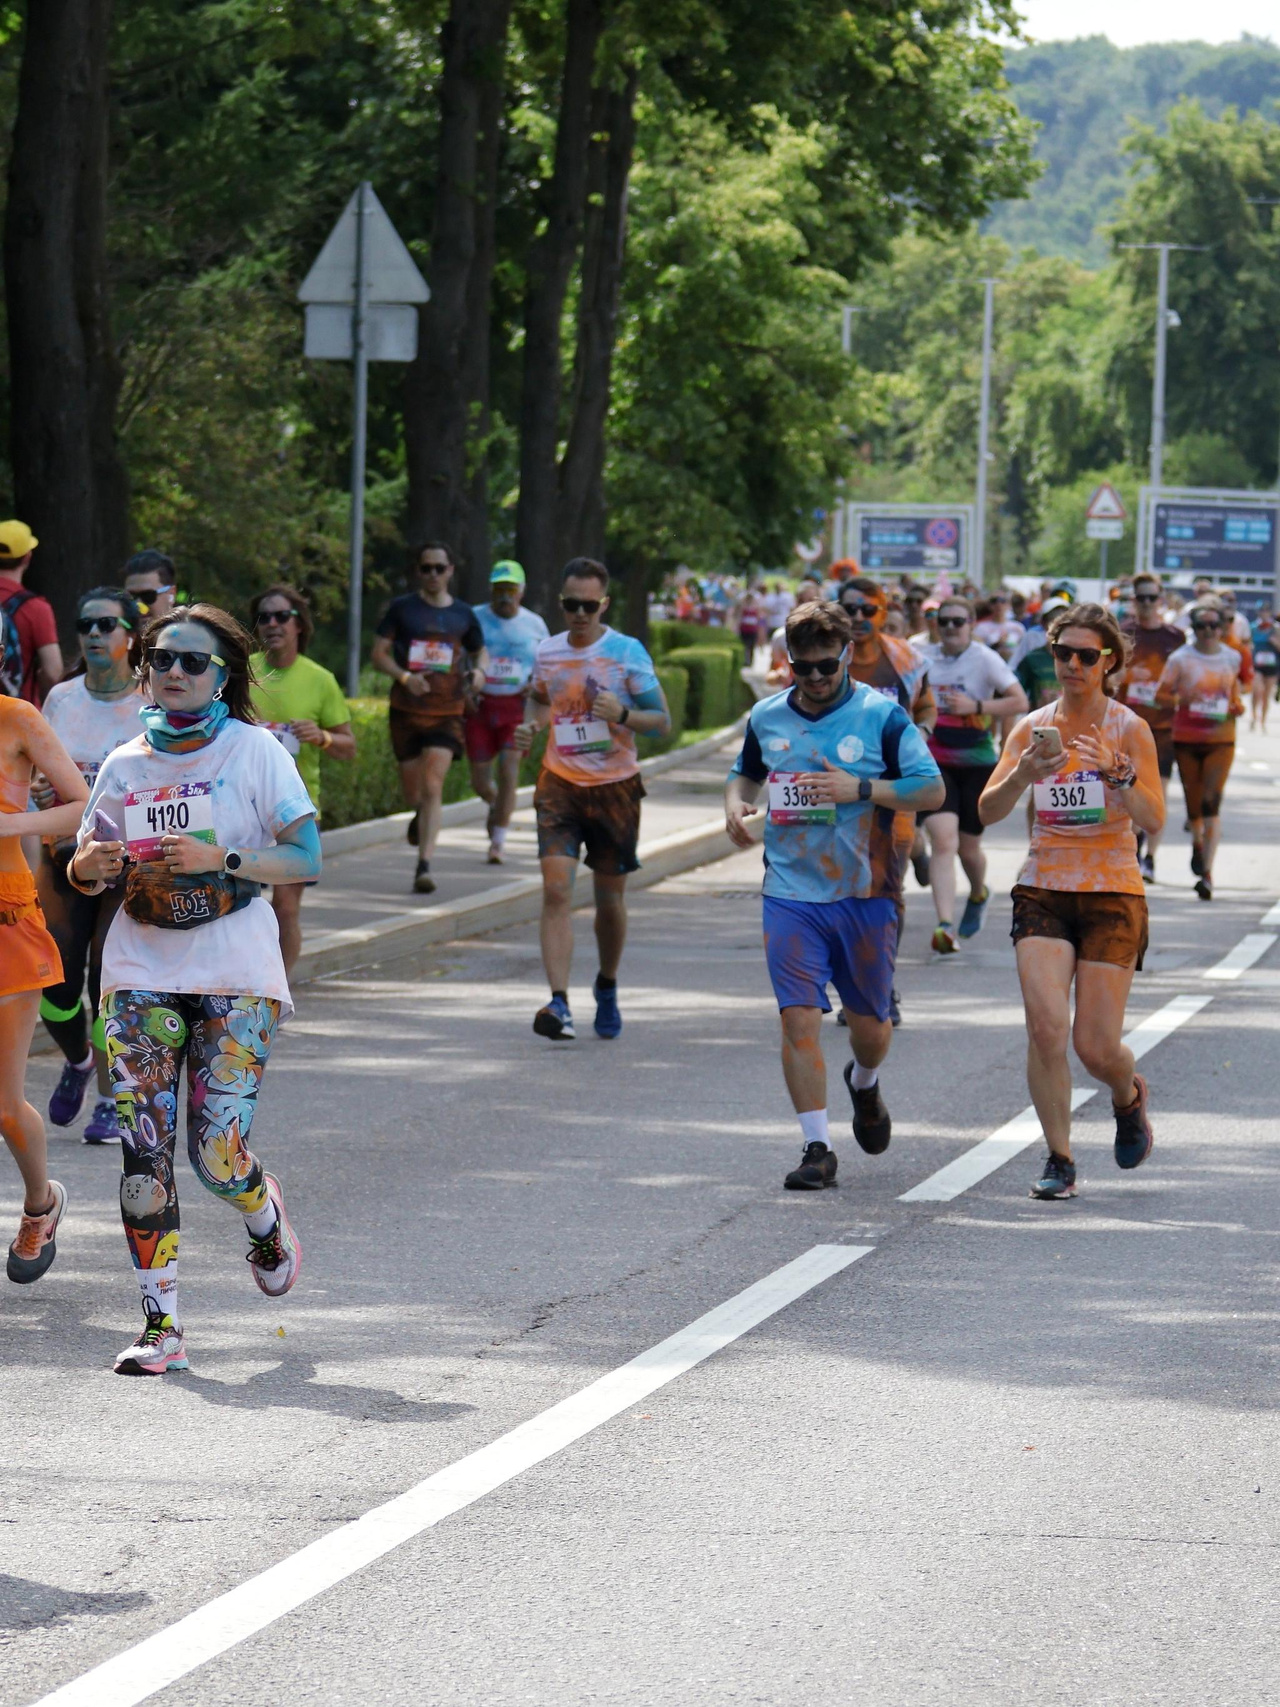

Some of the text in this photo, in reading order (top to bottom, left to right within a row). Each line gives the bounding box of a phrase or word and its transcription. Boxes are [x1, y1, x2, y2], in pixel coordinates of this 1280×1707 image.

[576, 726, 587, 741] 11
[1050, 786, 1086, 807] 3362
[147, 801, 189, 833] 4120
